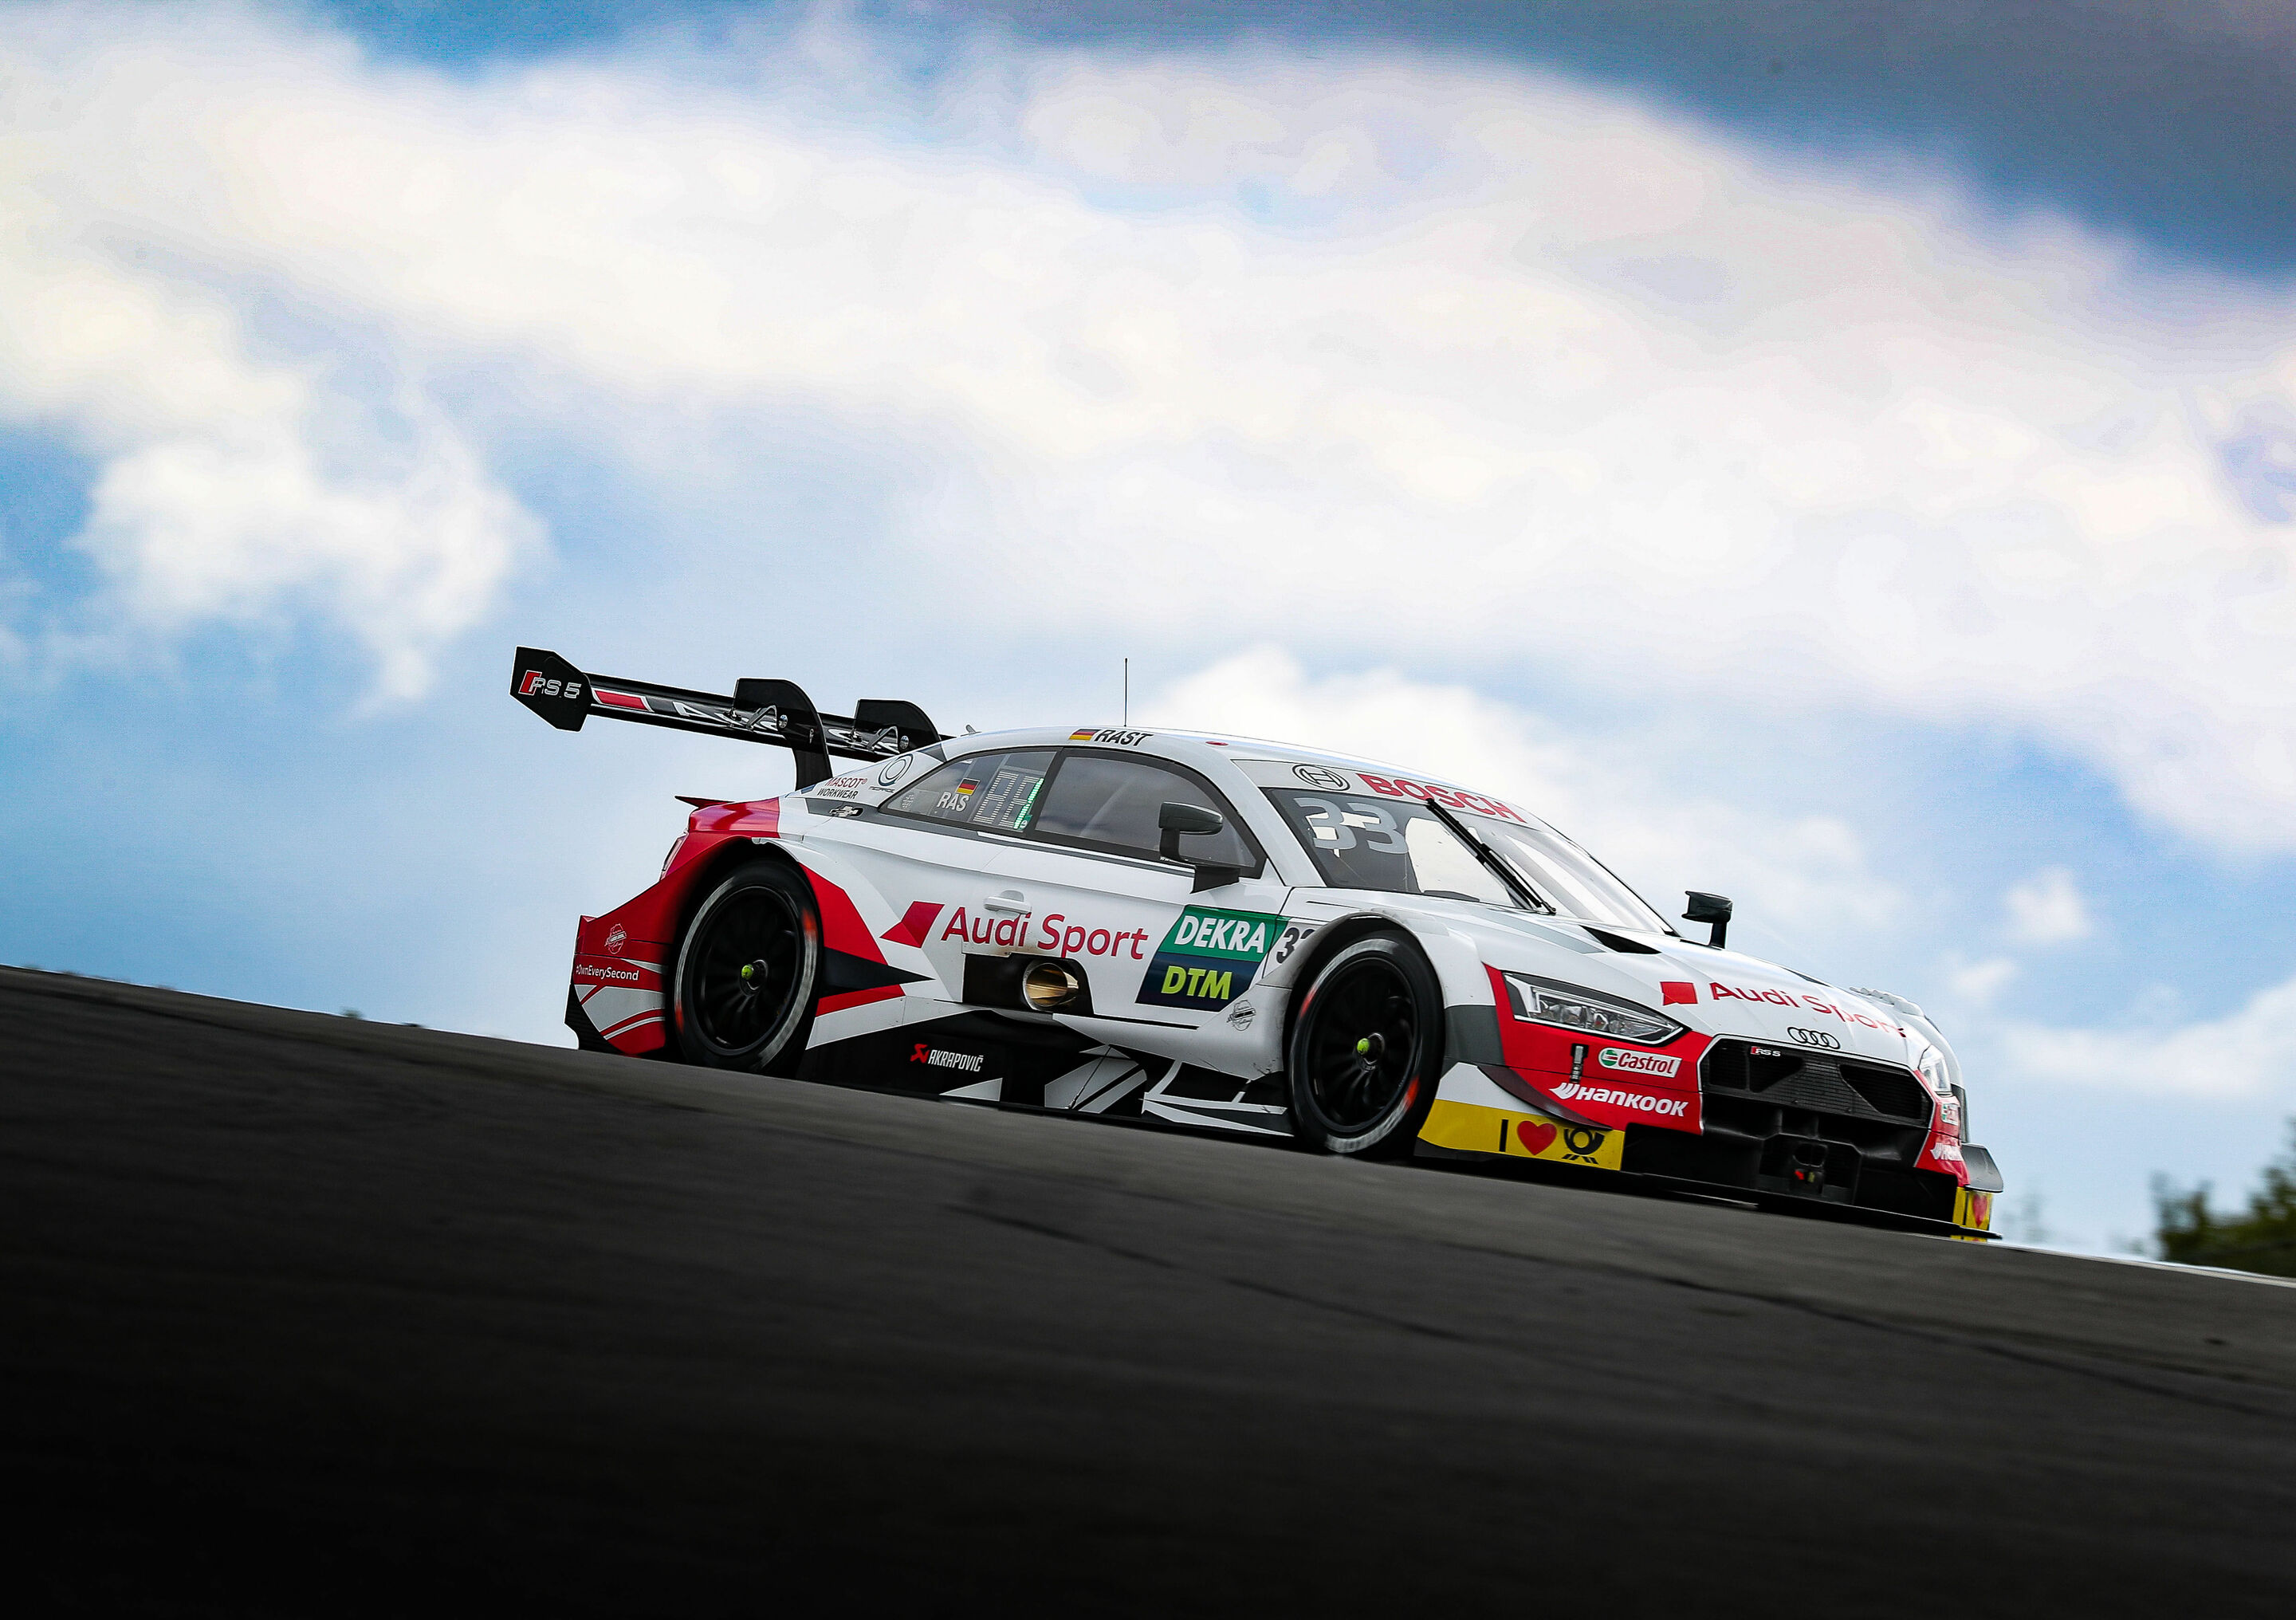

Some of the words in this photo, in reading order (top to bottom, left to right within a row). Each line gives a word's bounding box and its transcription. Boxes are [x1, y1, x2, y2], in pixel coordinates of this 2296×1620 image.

[1094, 729, 1154, 747] RAST
[816, 788, 859, 800] WORKWEAR
[936, 791, 969, 812] RAS
[1355, 773, 1527, 824] BOSCH
[1293, 797, 1409, 854] 33
[941, 906, 1032, 947] Audi
[1036, 913, 1150, 960] Sport
[1174, 914, 1267, 954] DEKRA
[1276, 927, 1316, 964] 3
[1160, 965, 1233, 1001] DTM
[1709, 981, 1801, 1009] Audi
[1801, 995, 1907, 1038] Sport
[1618, 1052, 1675, 1074] Castrol
[1498, 1119, 1509, 1153] I
